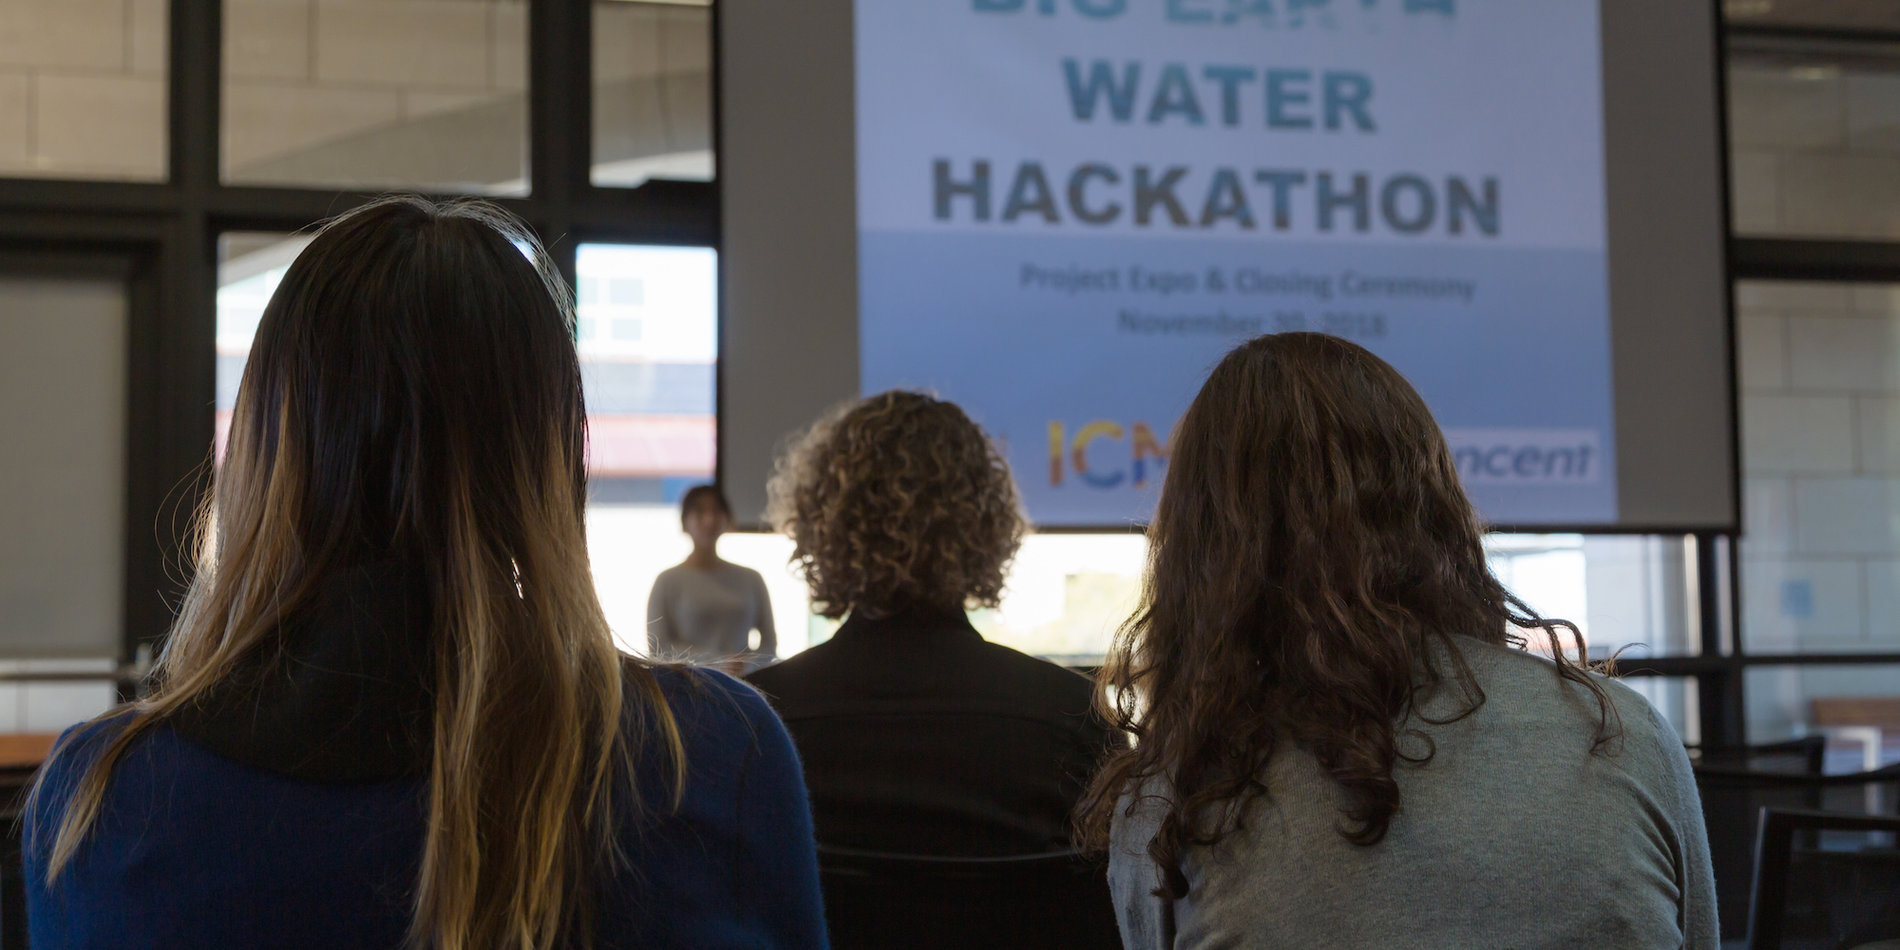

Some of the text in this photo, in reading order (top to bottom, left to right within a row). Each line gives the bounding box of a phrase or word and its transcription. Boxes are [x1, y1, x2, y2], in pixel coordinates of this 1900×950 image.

[1062, 57, 1377, 132] WATER
[931, 158, 1501, 237] HACKATHON
[1020, 264, 1476, 304] Project Expo & Closing Ceremony
[1116, 308, 1262, 337] November
[1453, 441, 1593, 478] ncent
